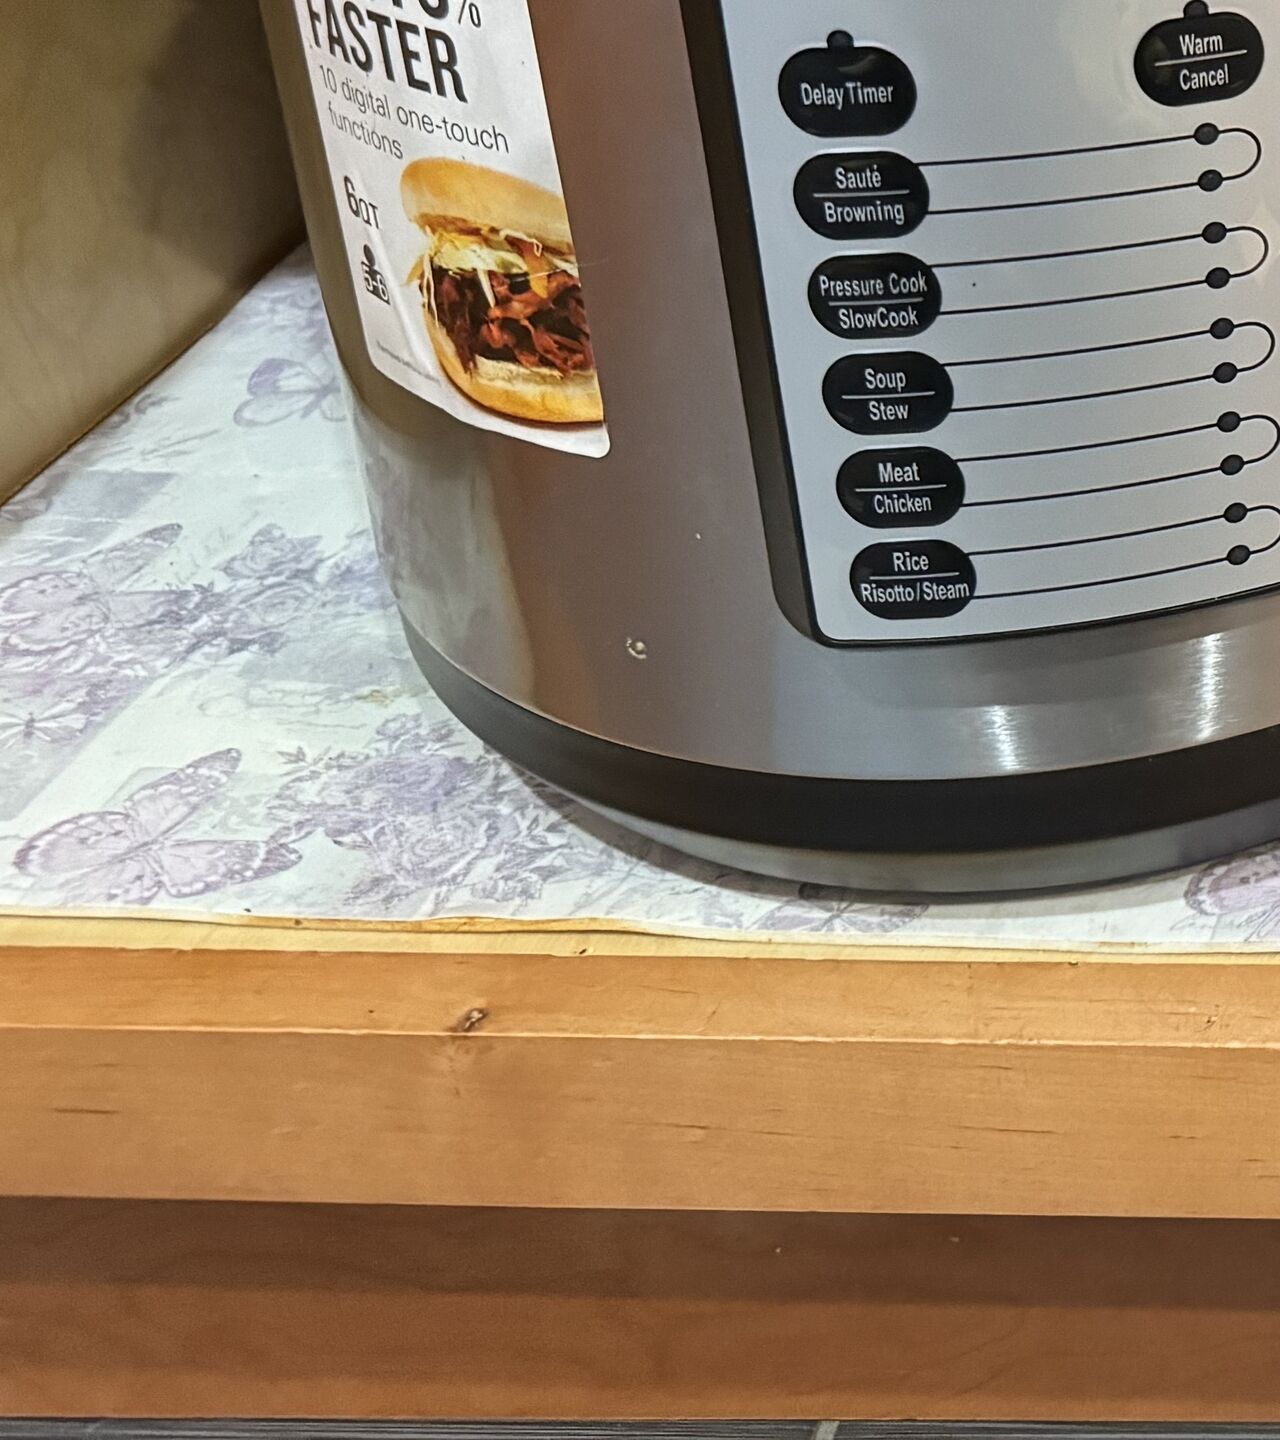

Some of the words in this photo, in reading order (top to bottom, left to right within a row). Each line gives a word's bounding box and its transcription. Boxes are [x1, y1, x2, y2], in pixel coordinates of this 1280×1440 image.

[1179, 33, 1224, 56] Warm
[1179, 64, 1230, 91] Cancel
[801, 81, 844, 110] Delay
[846, 81, 894, 105] Timer
[320, 64, 338, 94] 10
[342, 78, 391, 121] digital
[396, 105, 510, 154] one-touch
[328, 100, 404, 160] functions
[835, 164, 882, 190] Sauté
[824, 200, 905, 225] Browning
[819, 274, 884, 297] Pressure
[889, 271, 928, 294] Cook
[838, 306, 920, 330] SlowCook
[864, 368, 907, 392] Soup
[869, 400, 909, 421] Stew
[878, 462, 921, 484] Meat
[873, 493, 932, 515] Chicken
[892, 551, 929, 572] Rice
